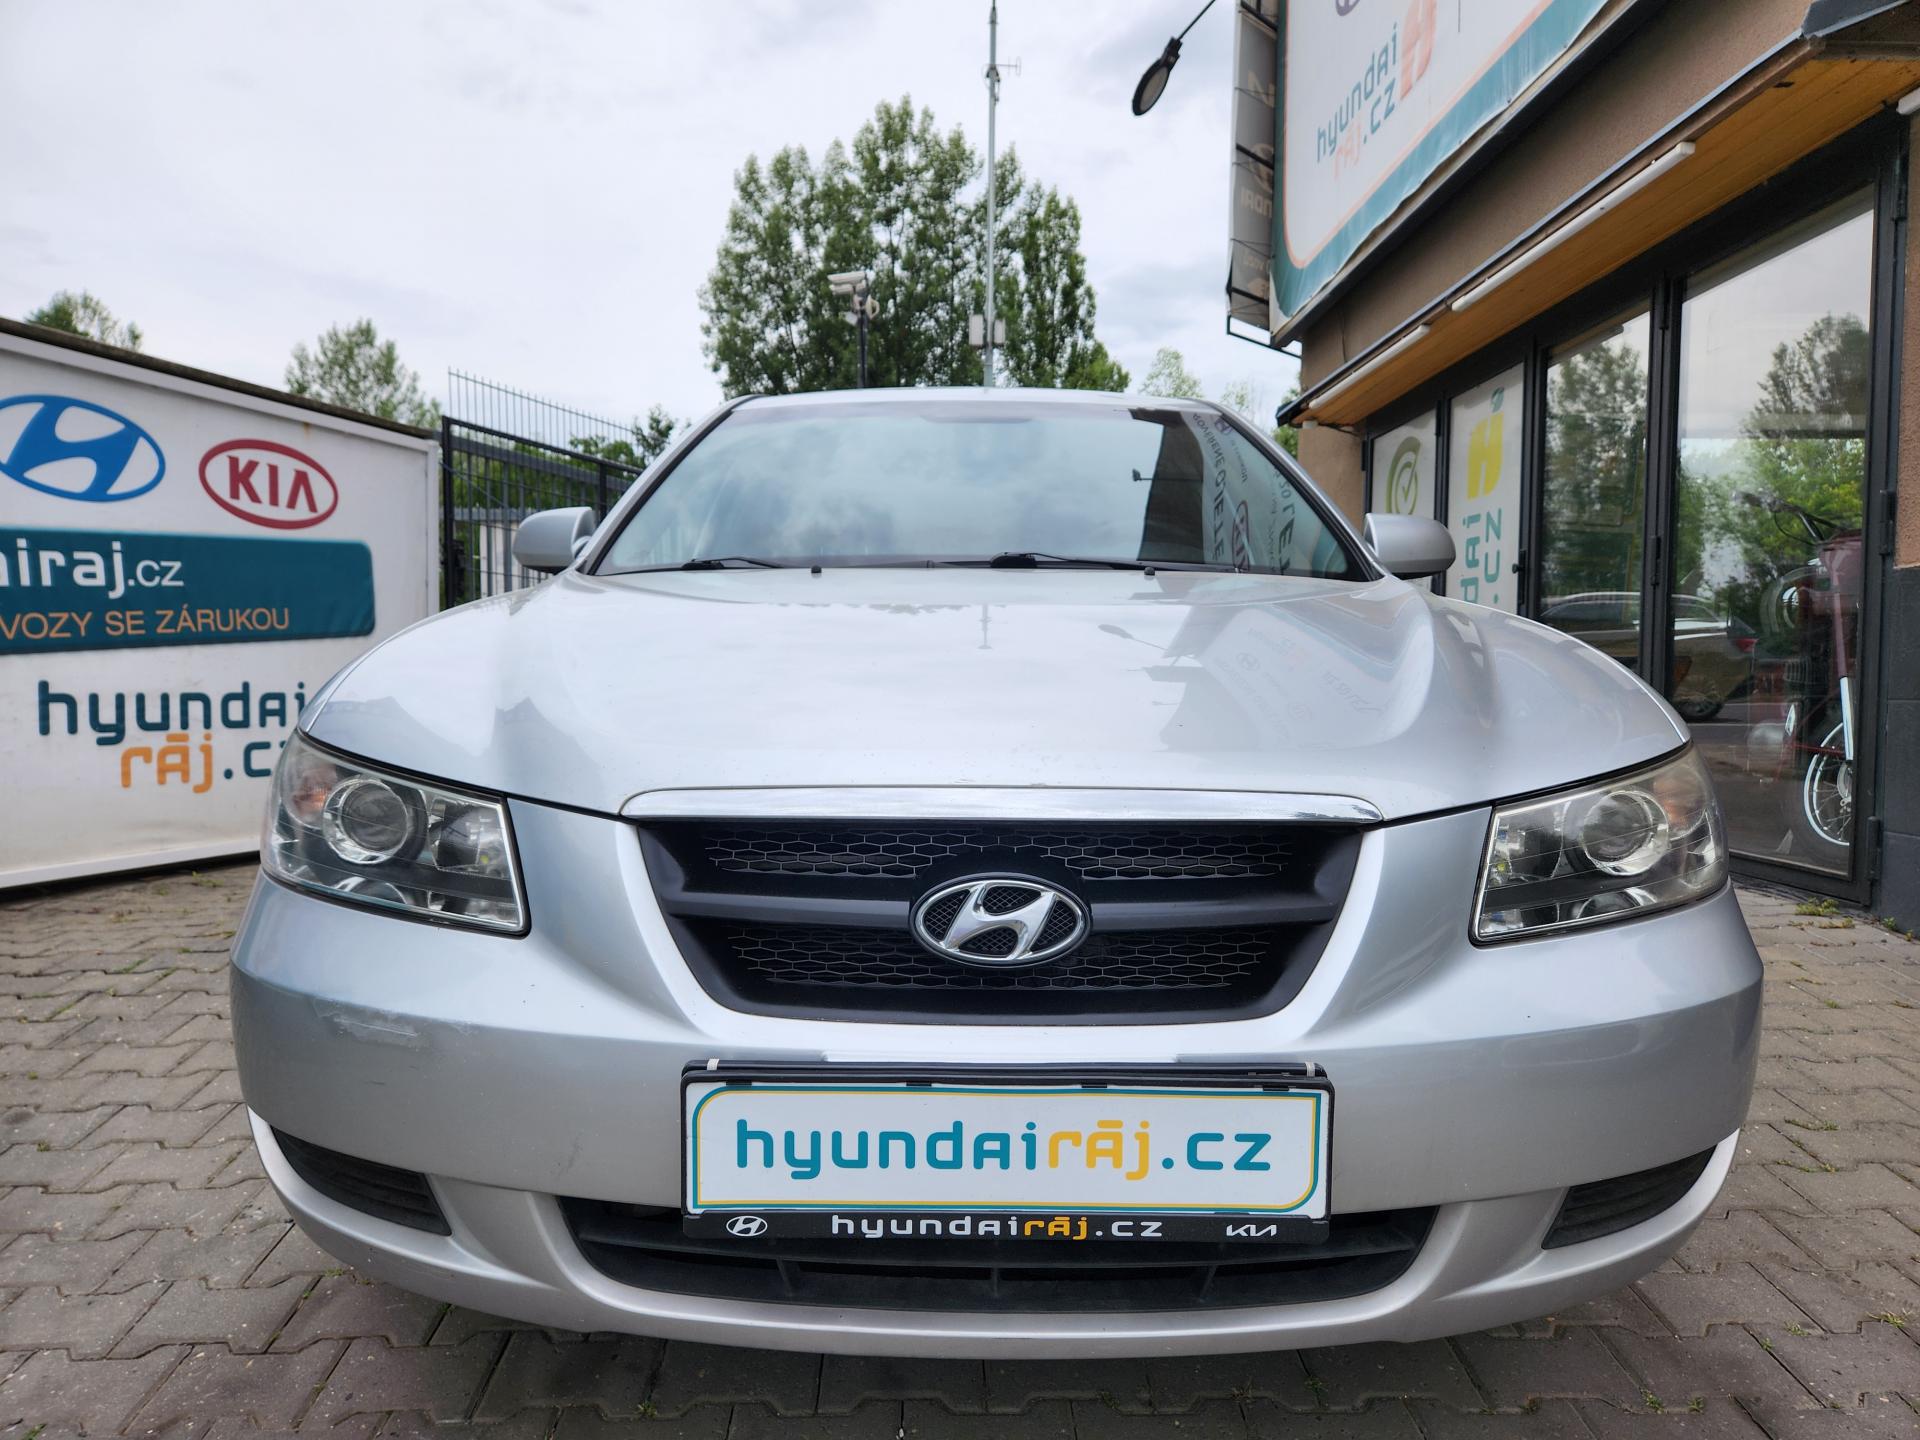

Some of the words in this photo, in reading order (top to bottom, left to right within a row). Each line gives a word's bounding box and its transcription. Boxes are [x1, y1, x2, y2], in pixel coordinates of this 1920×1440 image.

[227, 455, 318, 514] KIA
[0, 538, 185, 599] iraj.cz
[0, 611, 92, 640] VOZY
[105, 610, 146, 636] SE
[155, 604, 289, 633] ZÁRUKOU
[38, 680, 305, 746] hyundai
